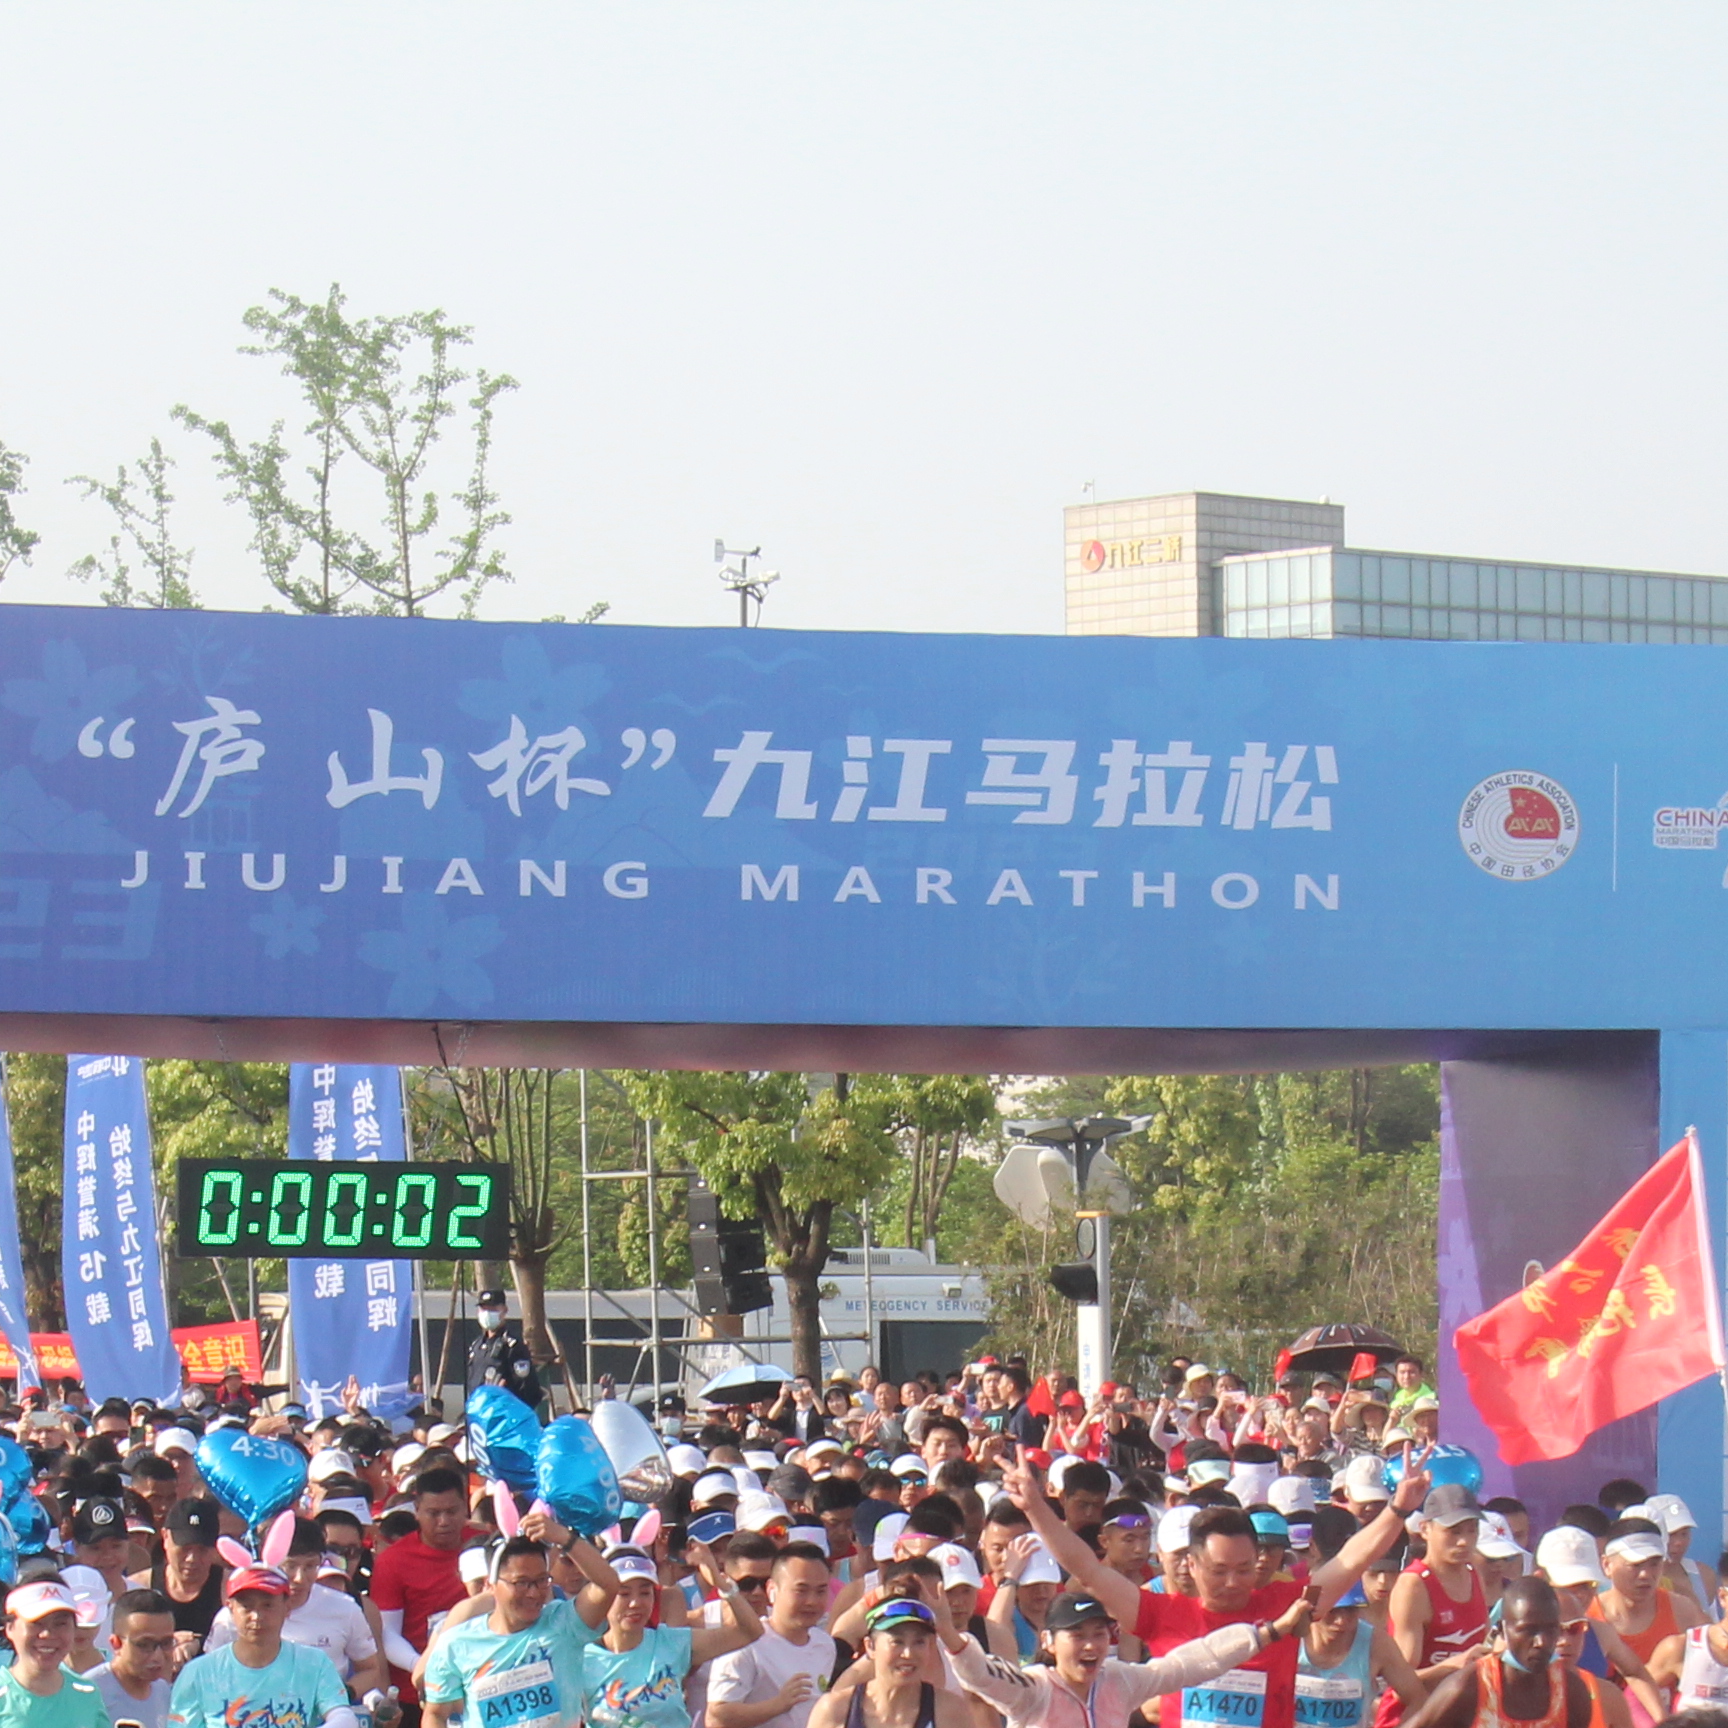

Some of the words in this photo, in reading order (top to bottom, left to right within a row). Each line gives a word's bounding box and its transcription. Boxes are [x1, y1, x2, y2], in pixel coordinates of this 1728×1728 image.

[1462, 795, 1486, 829] CHINESE
[1483, 774, 1534, 794] ATHLETICS
[1536, 779, 1575, 831] ASSOCIATION
[1655, 828, 1715, 836] MARATHON
[1468, 842, 1571, 878] 中国田径协会
[121, 850, 650, 899] JIUJIANG
[740, 863, 1340, 911] MARATHON
[197, 1169, 492, 1249] 0:00:02
[230, 1435, 297, 1469] 4:30
[1186, 1691, 1258, 1718] A1470
